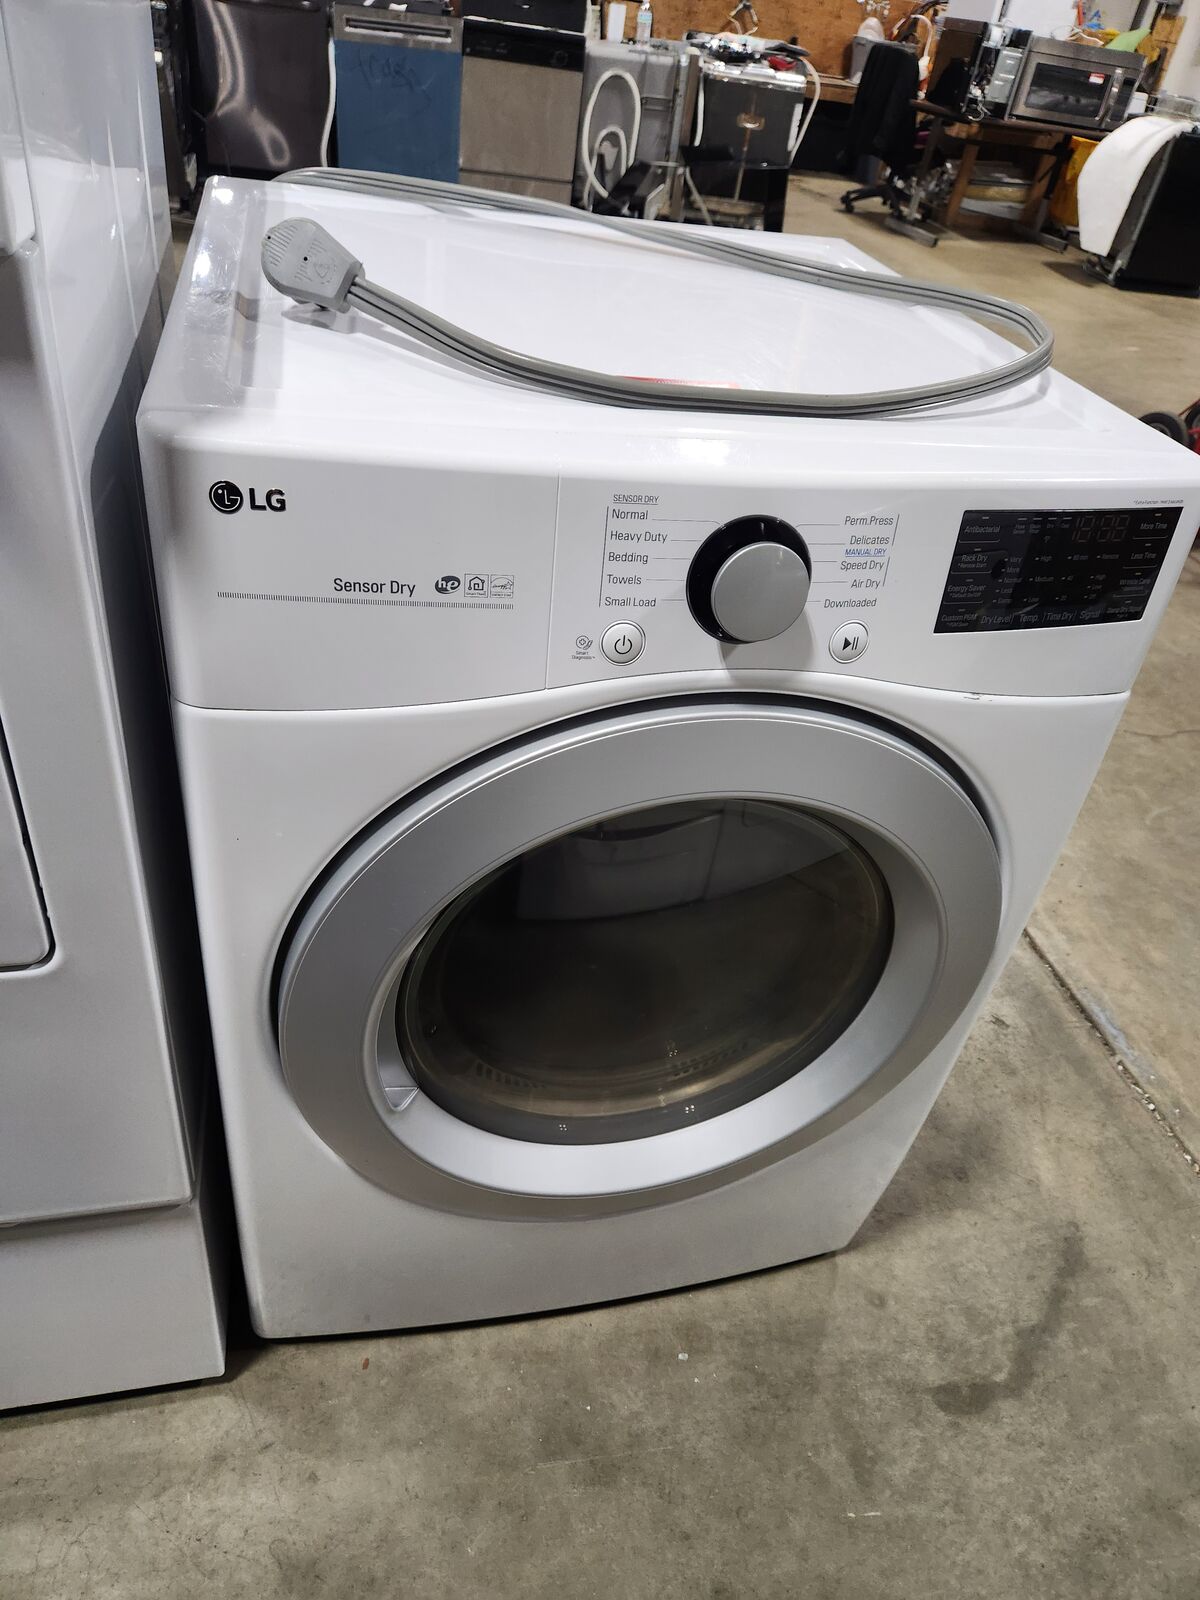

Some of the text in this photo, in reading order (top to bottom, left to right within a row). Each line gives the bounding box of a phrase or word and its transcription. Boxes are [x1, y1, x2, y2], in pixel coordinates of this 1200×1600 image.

[248, 488, 287, 512] LG
[613, 494, 659, 503] SENSOR DRY
[612, 509, 649, 520] Normal
[845, 515, 894, 526] Perm.Press
[964, 525, 1001, 534] Antibacterial
[610, 530, 668, 544] Heavy Duty
[850, 535, 890, 546] Delicates
[608, 551, 649, 564] Bedding
[845, 548, 872, 556] MANUAL
[840, 560, 884, 572] Speed Dry
[607, 574, 642, 585] Towels
[851, 578, 881, 589] Air Dry
[333, 578, 386, 594] Sensor
[390, 579, 416, 598] Dry
[948, 585, 969, 593] Energy
[605, 597, 657, 607] Small Load
[824, 598, 877, 609] Downloaded
[980, 615, 1011, 624] Dry Level
[1020, 615, 1040, 624] Temp.
[1046, 612, 1073, 621] Time Dry
[1080, 610, 1101, 620] Signal
